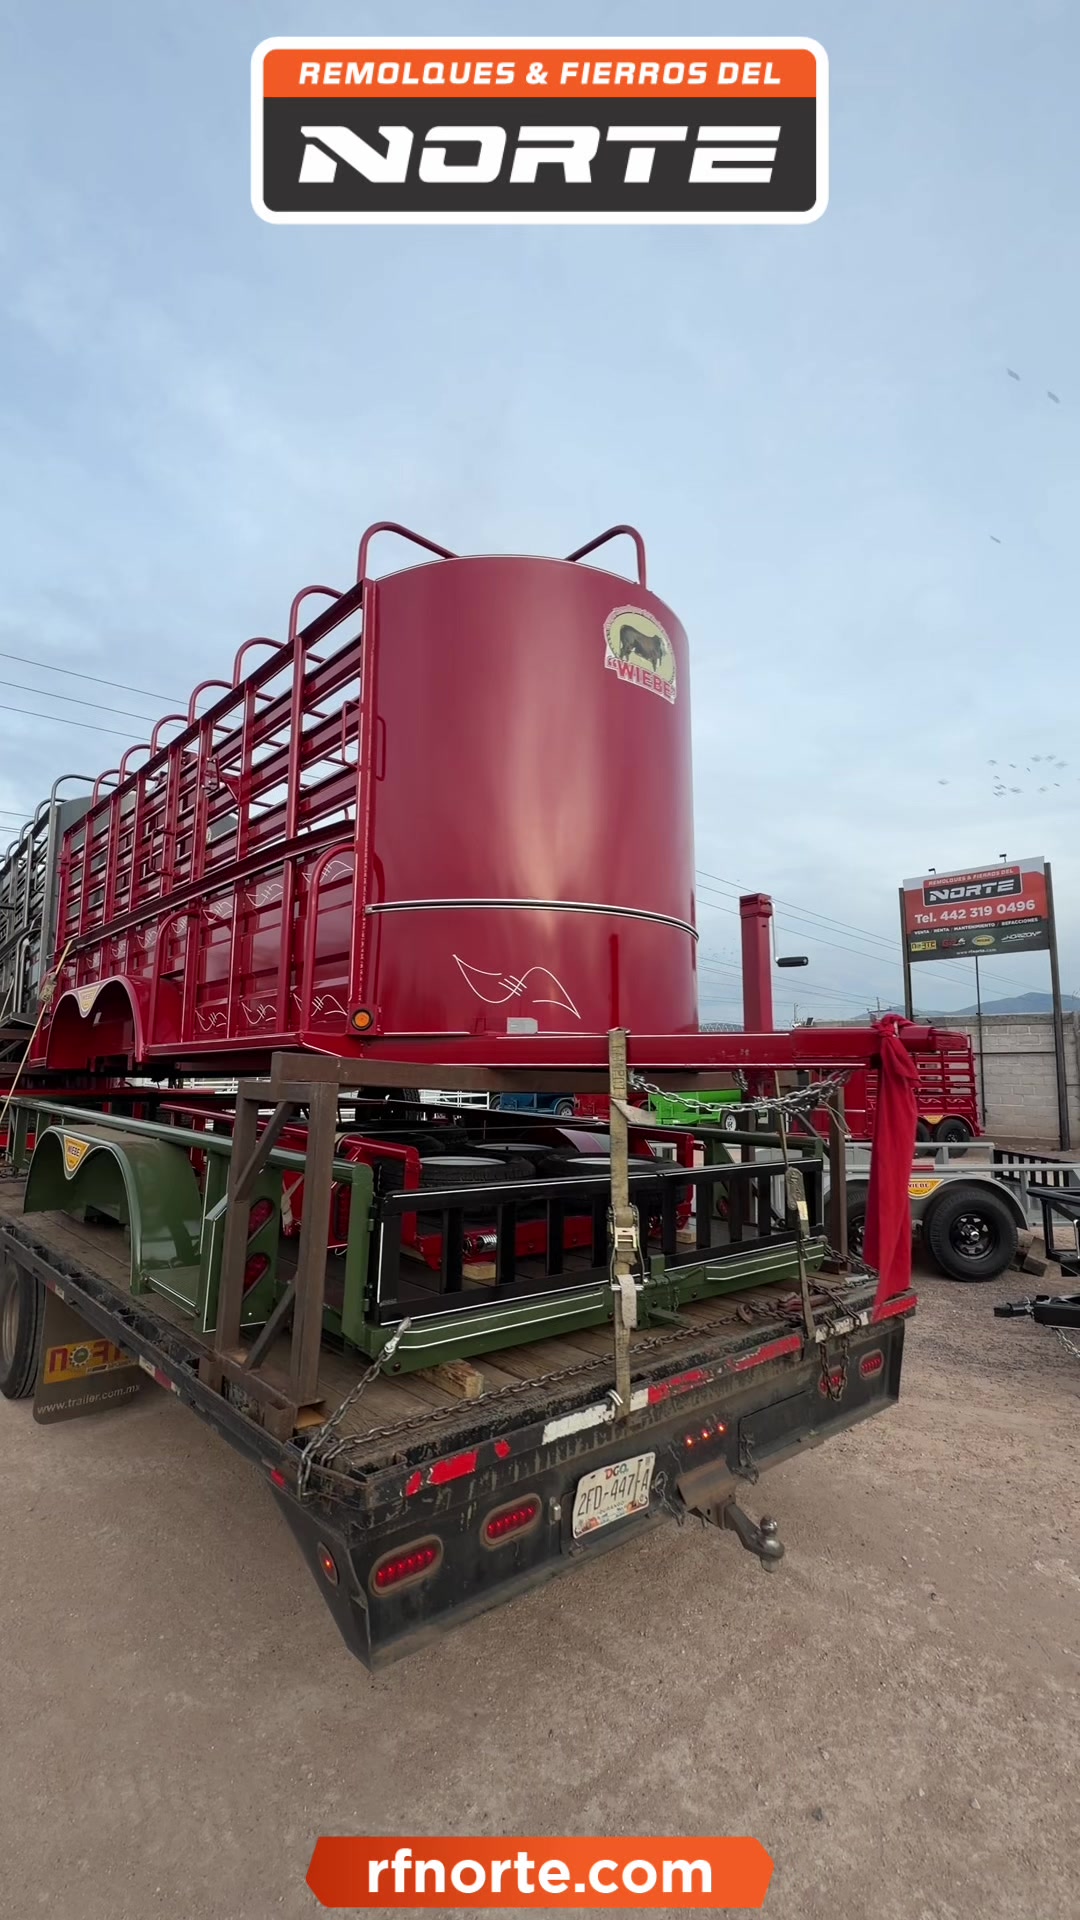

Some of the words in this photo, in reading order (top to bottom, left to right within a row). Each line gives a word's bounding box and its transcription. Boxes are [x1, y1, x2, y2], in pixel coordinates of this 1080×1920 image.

[929, 879, 1015, 902] NORTE
[914, 912, 937, 924] Tel.
[940, 909, 967, 921] 442
[969, 905, 993, 918] 319
[996, 899, 1036, 914] 0496
[953, 922, 996, 931] MANTENIMIENTO
[1001, 917, 1039, 927] REFACCIONES
